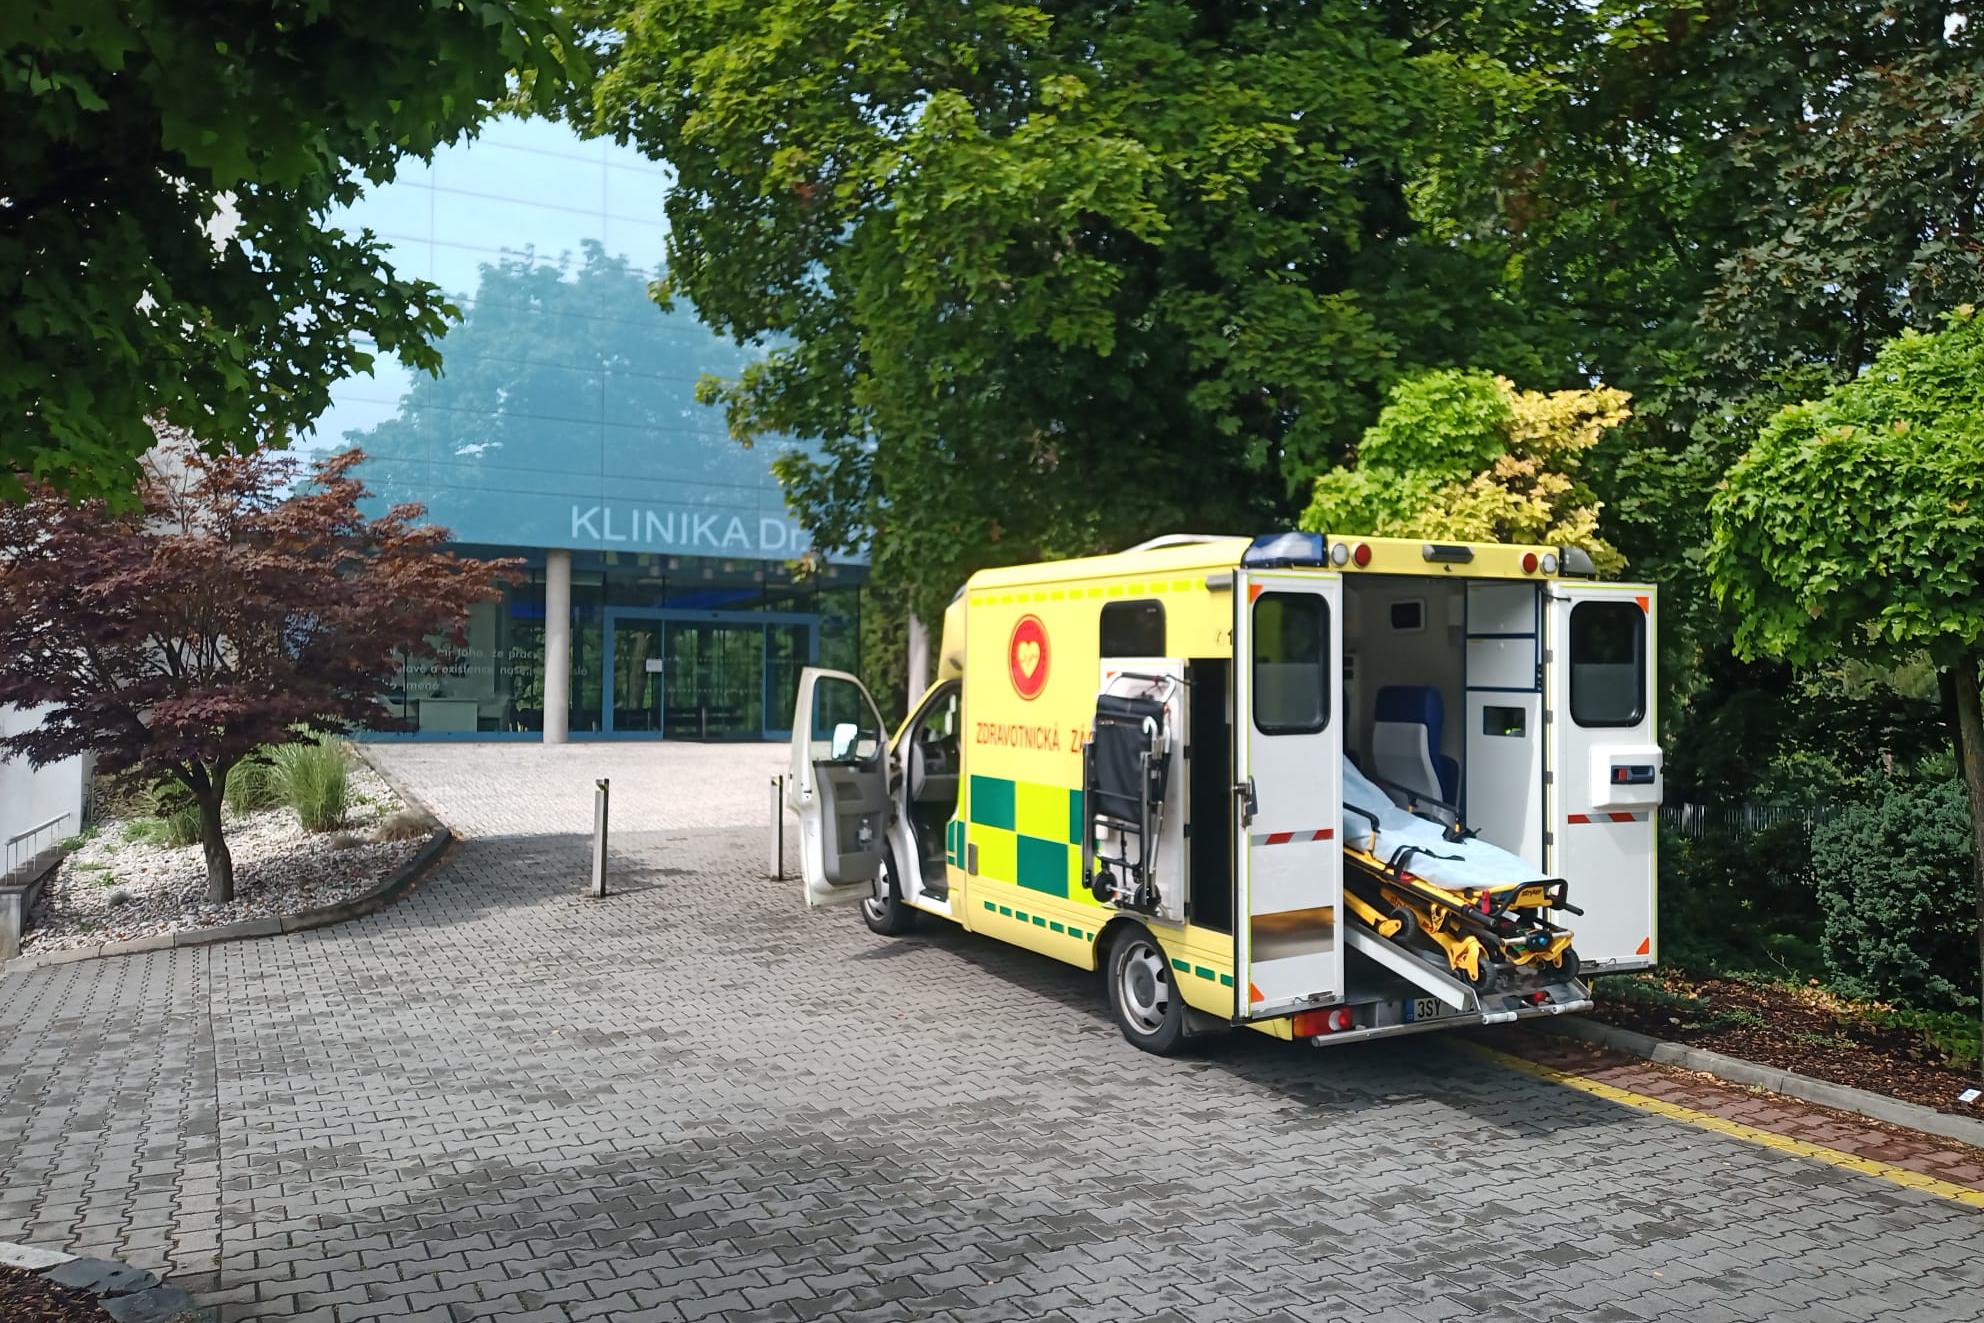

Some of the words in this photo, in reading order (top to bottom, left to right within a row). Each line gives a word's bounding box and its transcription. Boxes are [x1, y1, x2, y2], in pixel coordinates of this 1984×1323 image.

[571, 505, 750, 549] KLINIKA
[976, 721, 1060, 752] ZDRAVOTNICKÁ
[1417, 999, 1441, 1018] 3SY
